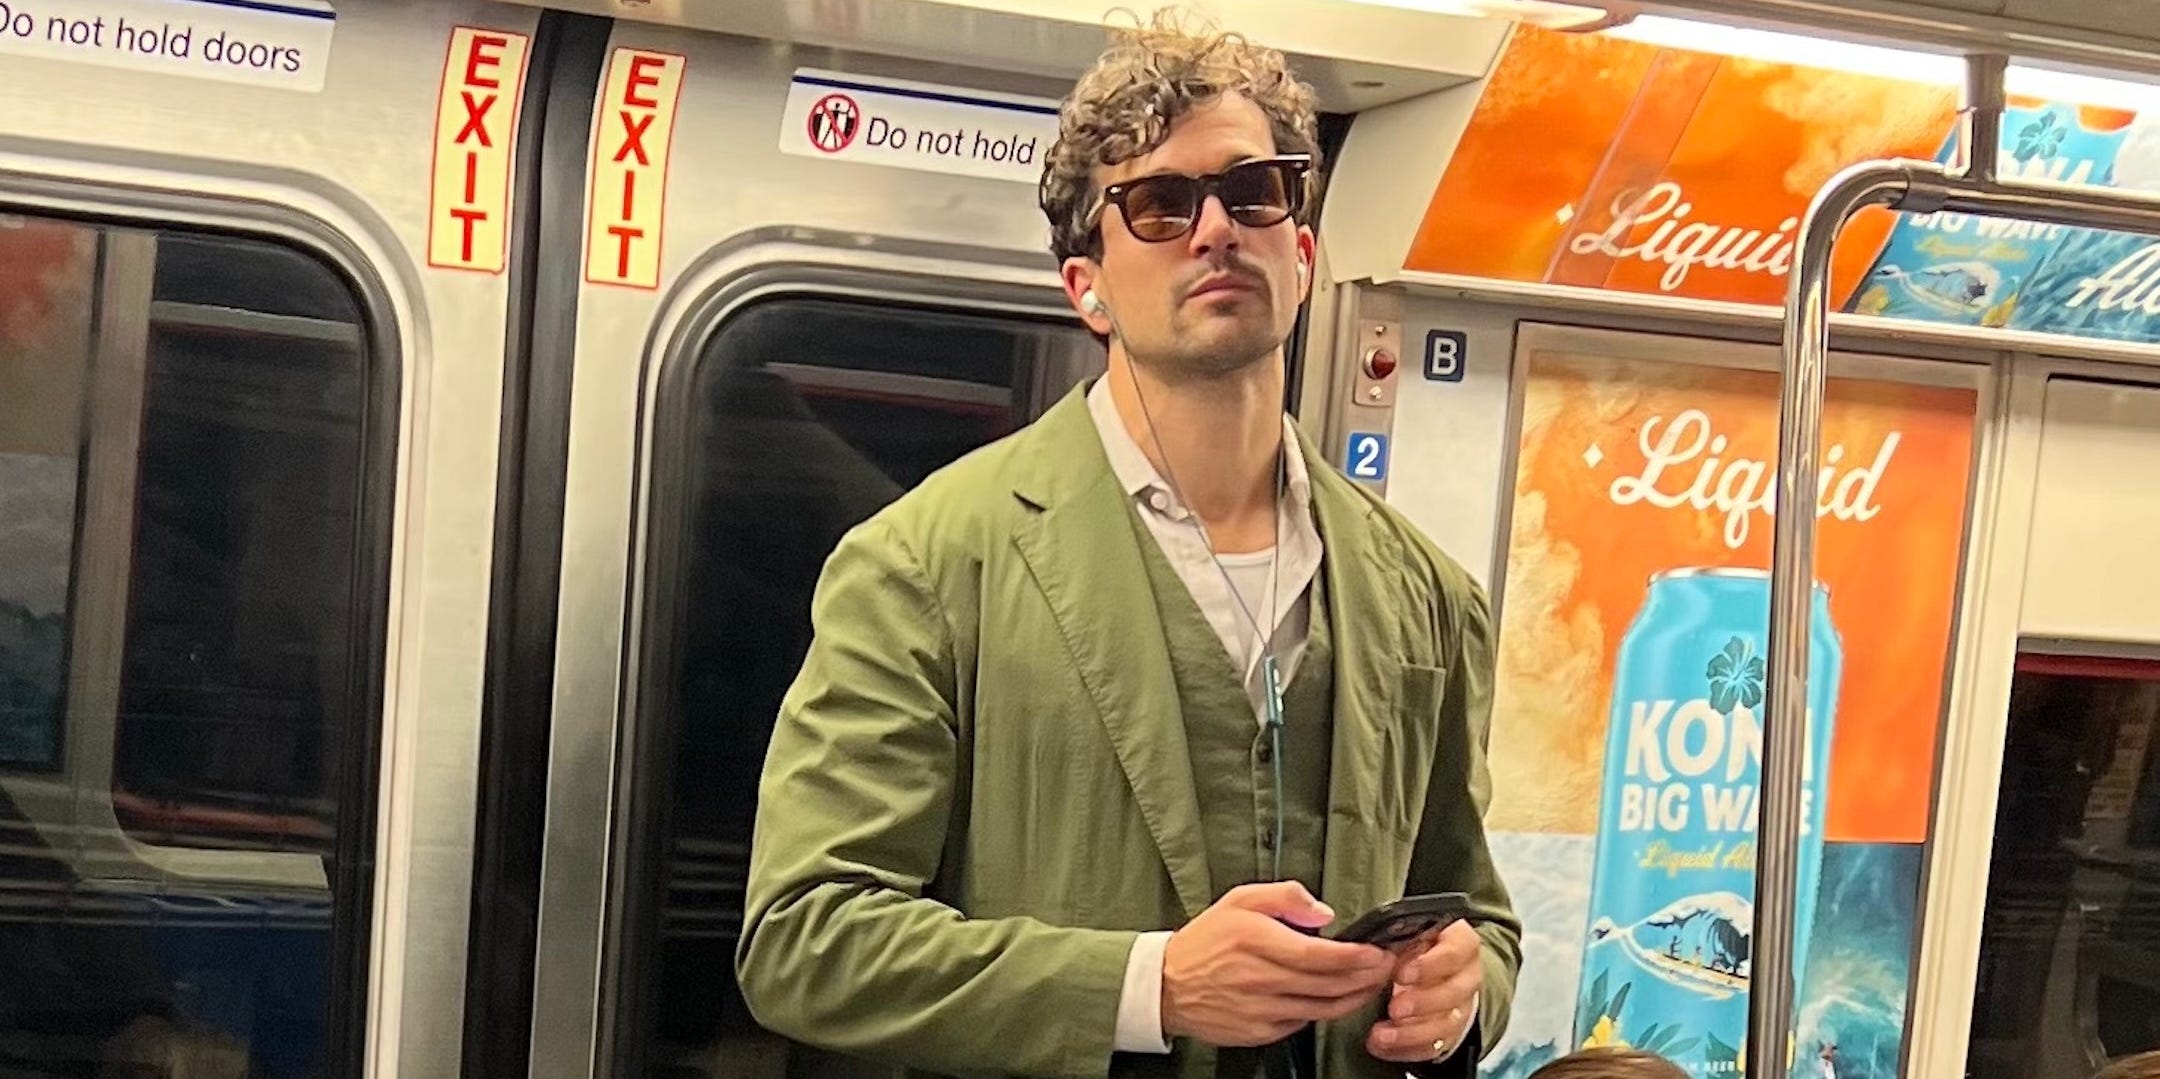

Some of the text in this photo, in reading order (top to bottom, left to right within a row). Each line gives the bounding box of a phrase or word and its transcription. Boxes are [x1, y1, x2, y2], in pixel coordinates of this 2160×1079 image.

[47, 16, 105, 47] not
[116, 17, 192, 58] hold
[203, 30, 302, 73] doors
[450, 35, 508, 263] EXIT
[606, 55, 666, 279] EXIT
[866, 117, 1037, 165] Do not hold
[1431, 336, 1458, 376] B
[1354, 436, 1380, 477] 2
[1624, 698, 1814, 783] KON
[1619, 782, 1691, 832] BIG
